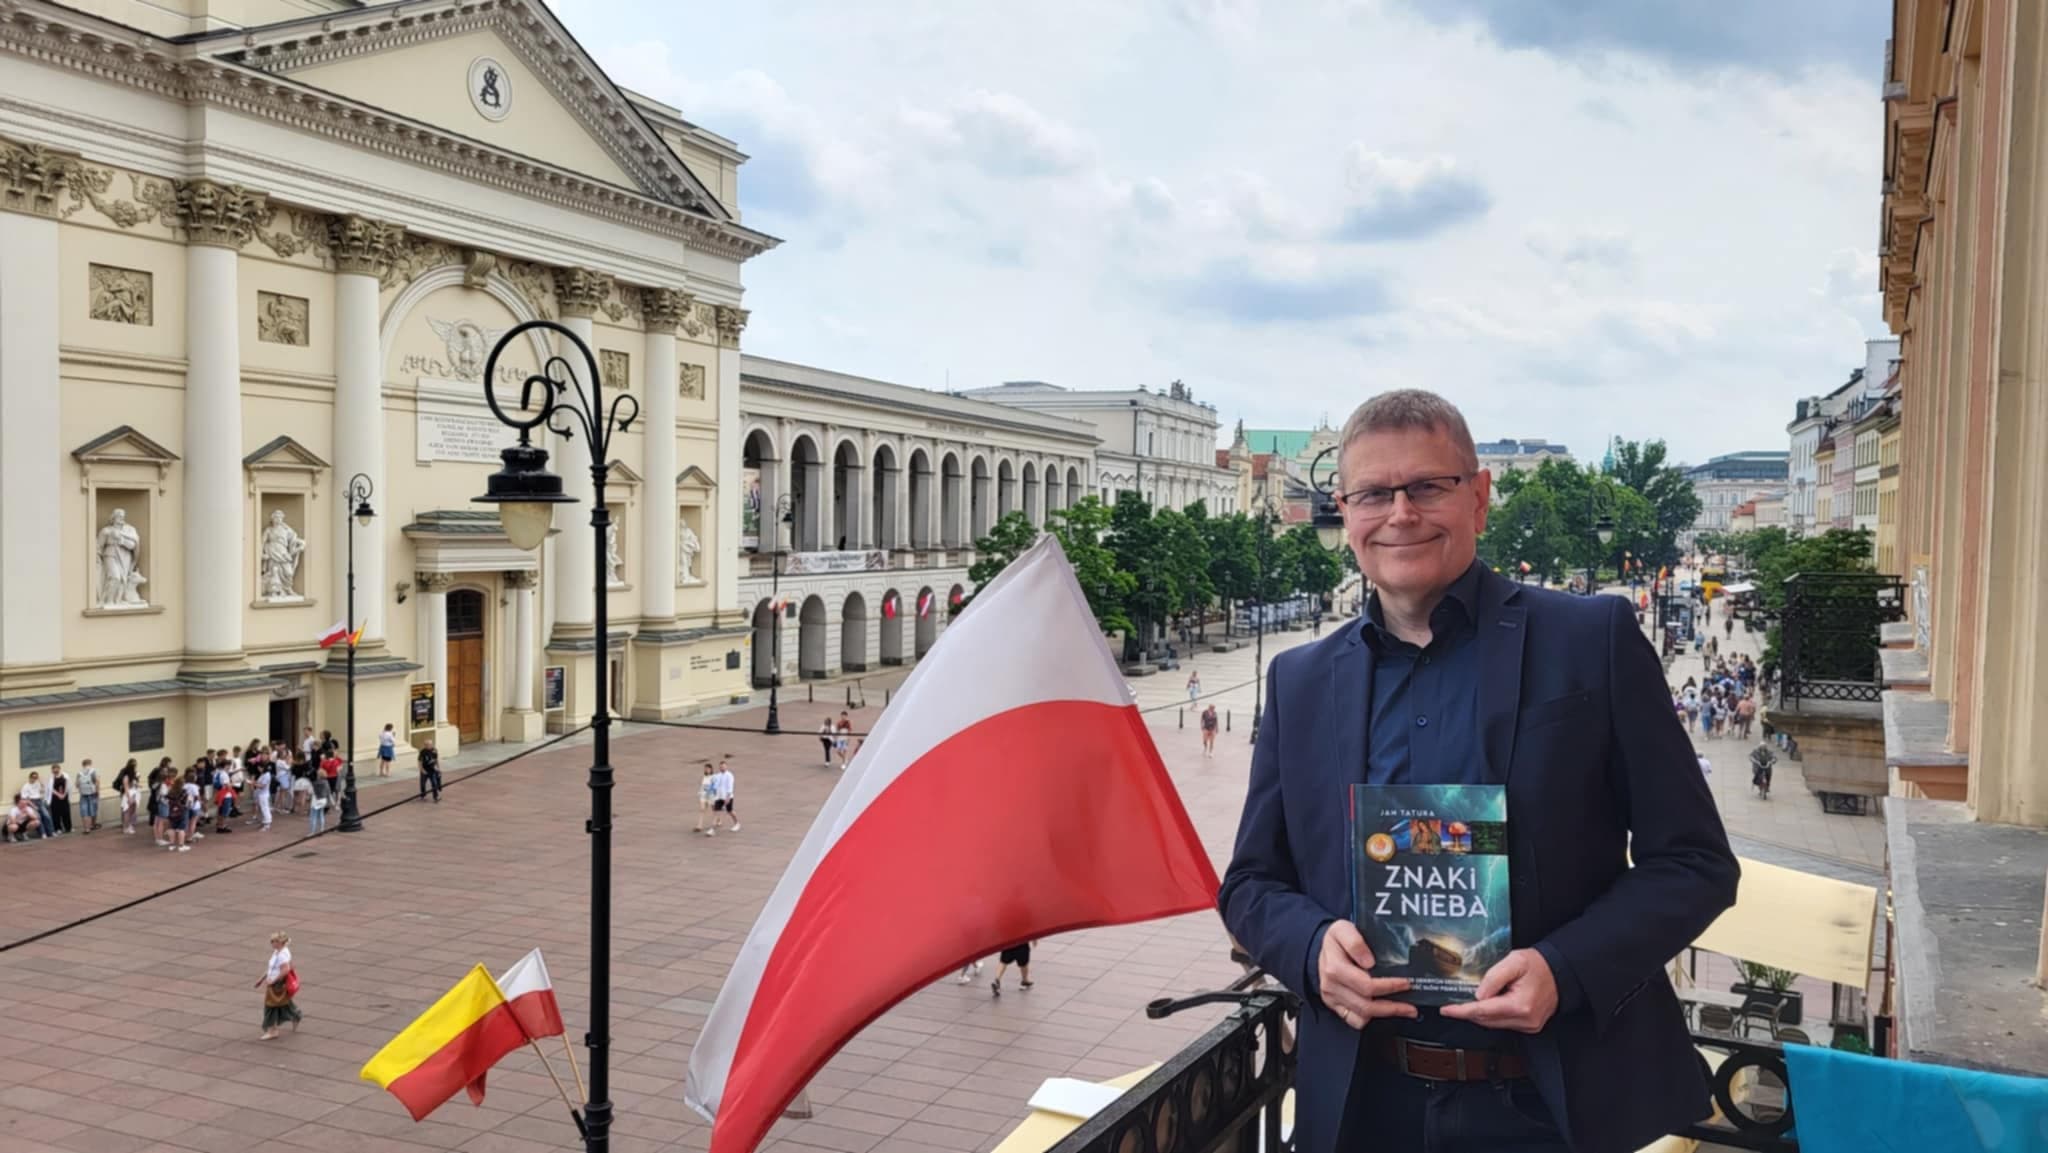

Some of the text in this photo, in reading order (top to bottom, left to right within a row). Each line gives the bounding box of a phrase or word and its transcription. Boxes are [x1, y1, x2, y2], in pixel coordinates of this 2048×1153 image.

[1380, 809, 1435, 817] JAN TATURA
[1375, 892, 1392, 915] Z
